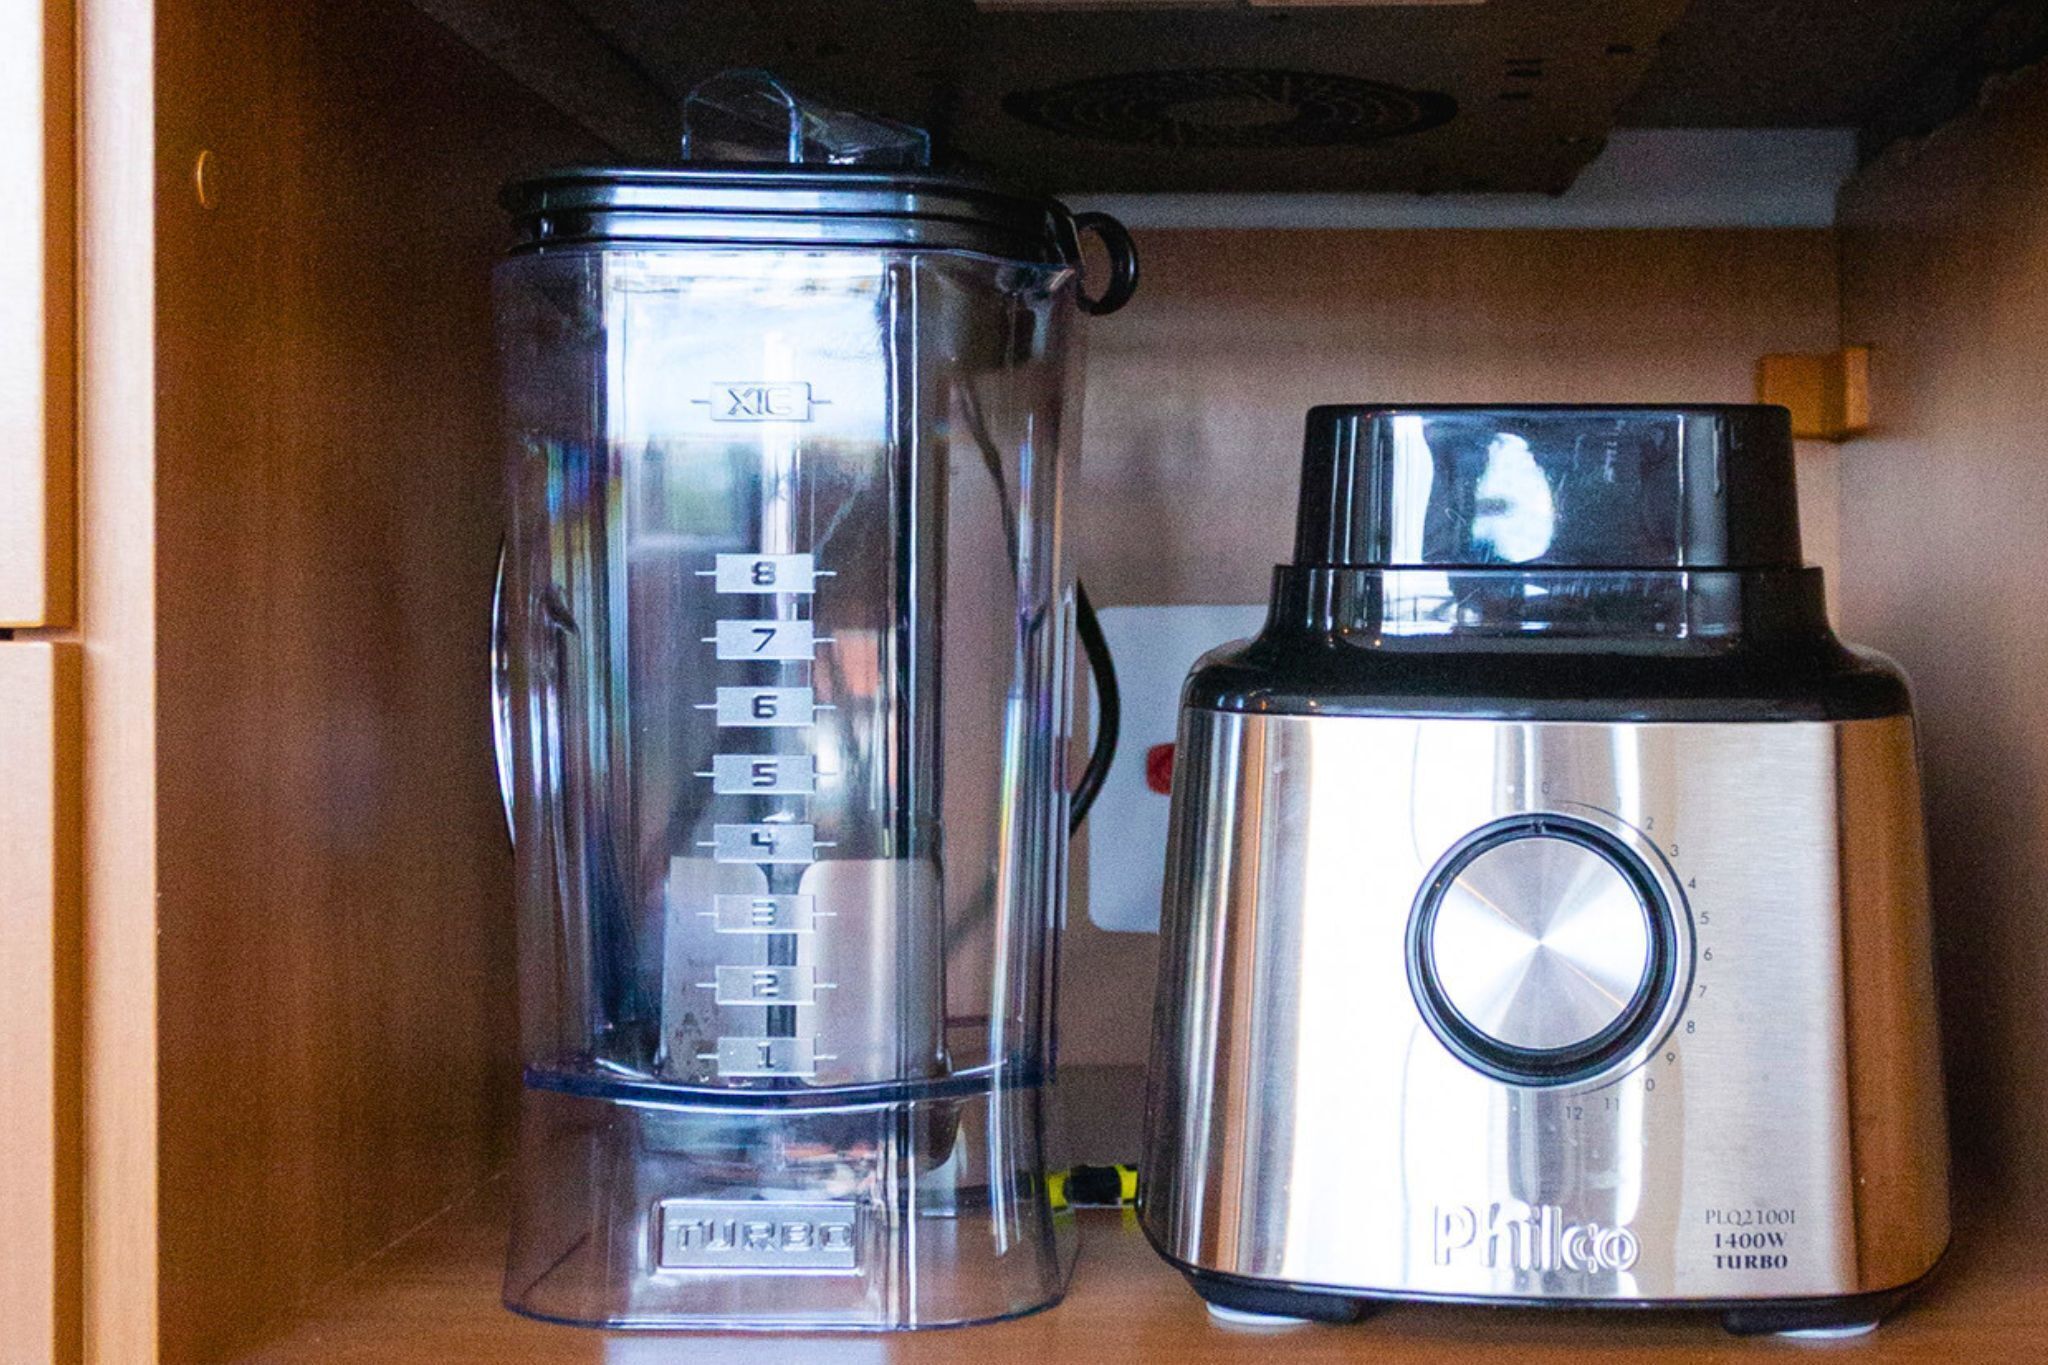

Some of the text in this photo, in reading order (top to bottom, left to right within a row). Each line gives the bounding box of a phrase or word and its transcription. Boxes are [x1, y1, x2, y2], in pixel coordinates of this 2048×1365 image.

[751, 561, 777, 586] 8
[752, 628, 777, 652] 7
[752, 695, 778, 719] 6
[752, 763, 778, 787] 5
[1646, 817, 1655, 831] 2
[751, 831, 775, 855] 4
[1671, 844, 1680, 857] 3
[1688, 877, 1697, 890] 4
[752, 901, 776, 926] 3
[1700, 911, 1710, 925] 5
[1703, 948, 1713, 961] 6
[752, 971, 778, 997] 2
[1699, 985, 1708, 998] 7
[1687, 1020, 1696, 1034] 8
[757, 1041, 776, 1068] 1
[1666, 1051, 1676, 1065] 9
[1605, 1097, 1620, 1111] 11
[1566, 1106, 1583, 1120] 12
[667, 1218, 856, 1251] TURBO
[1434, 1202, 1641, 1274] Philco
[1715, 1232, 1788, 1249] 1400W
[1713, 1254, 1788, 1270] TURBO
